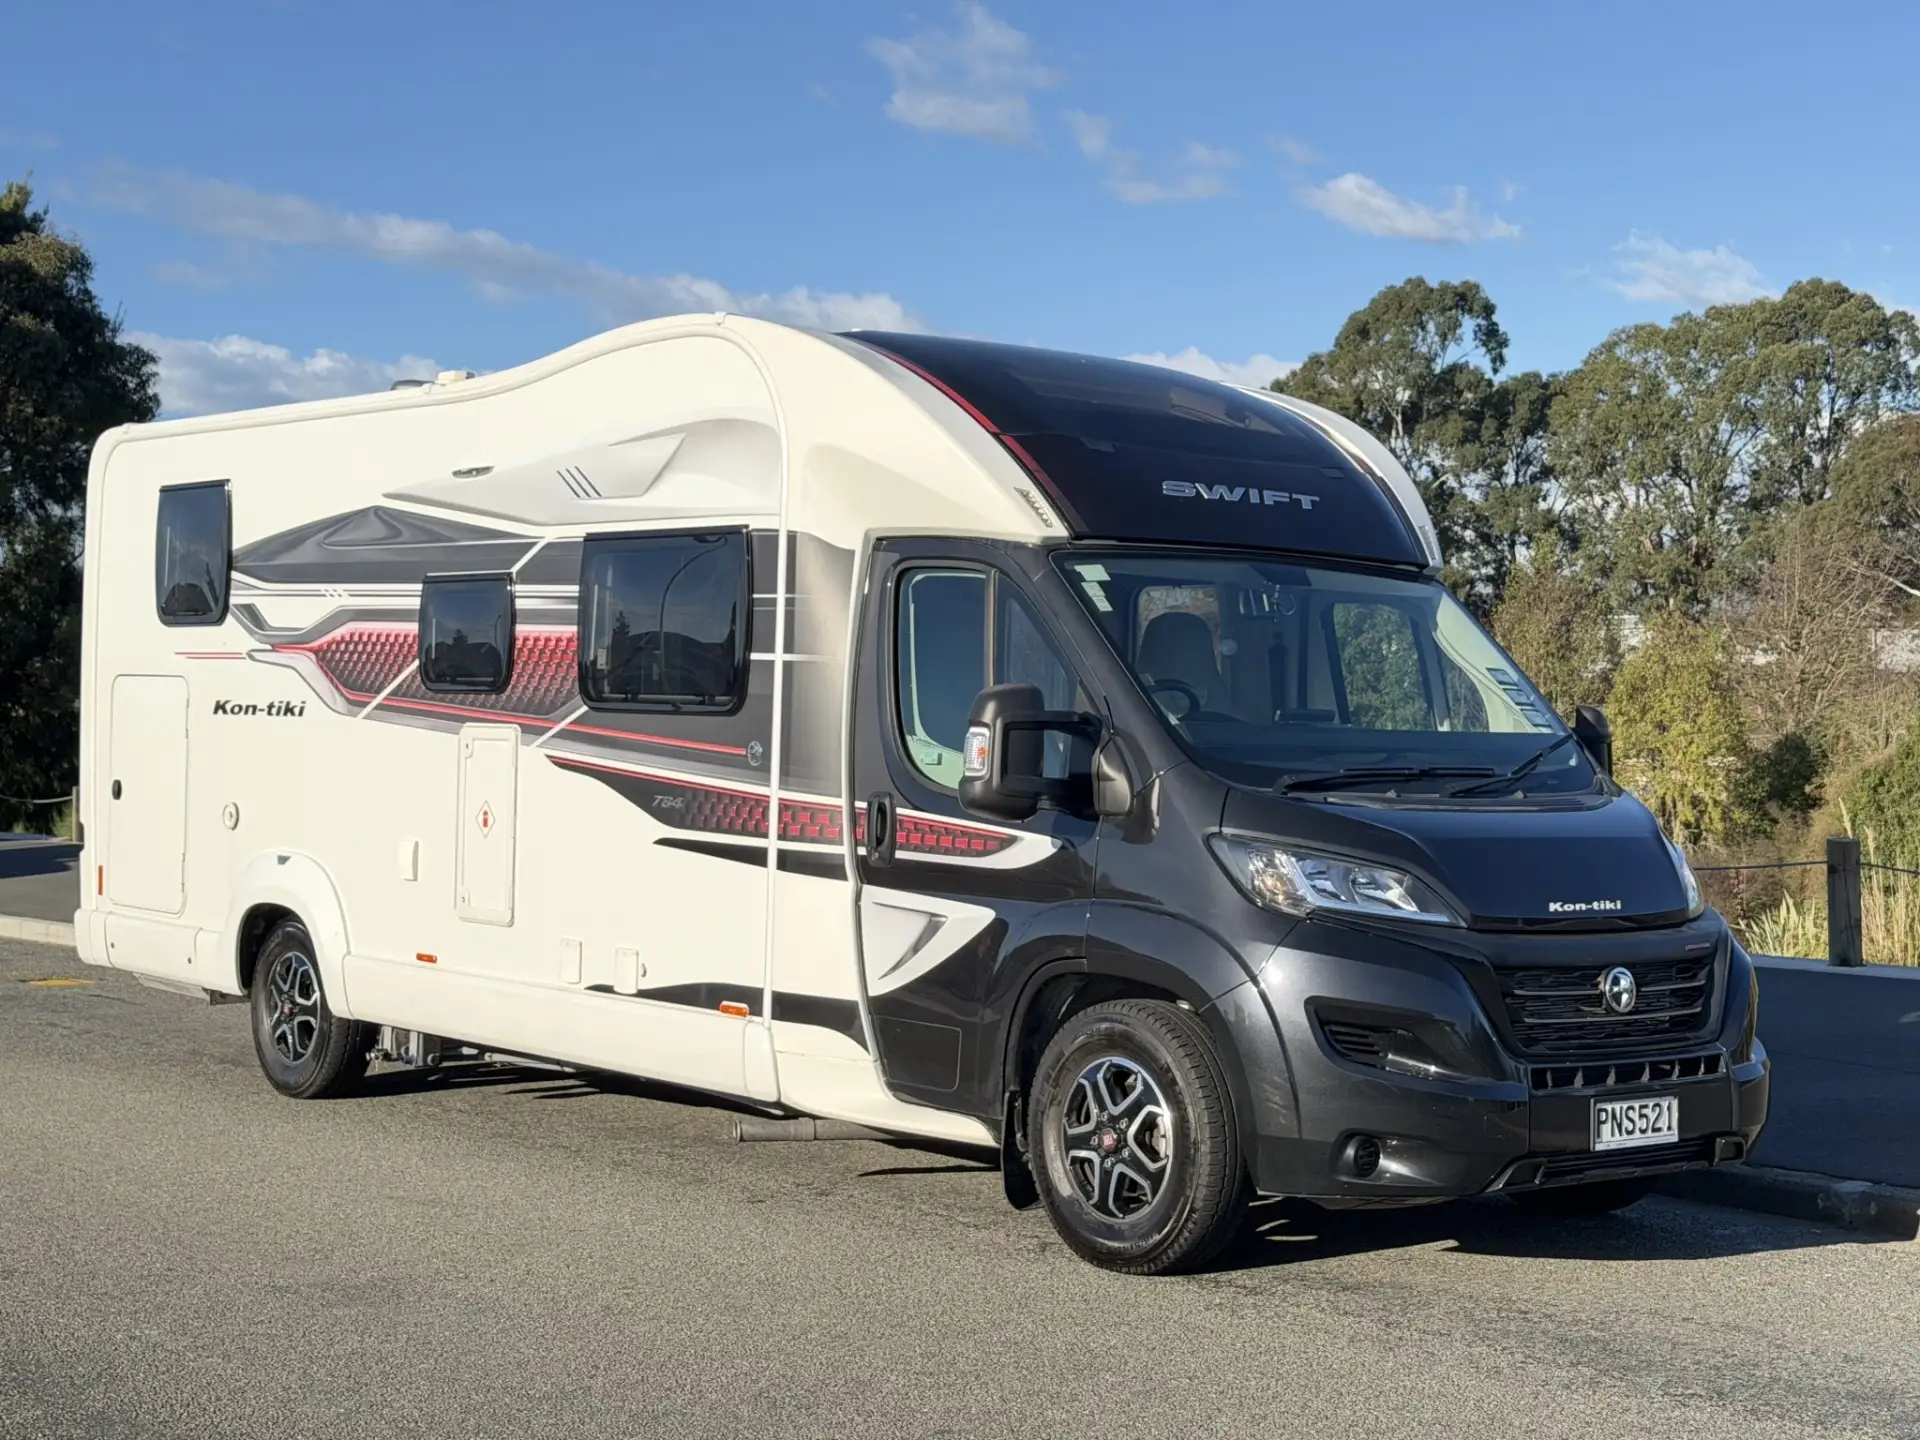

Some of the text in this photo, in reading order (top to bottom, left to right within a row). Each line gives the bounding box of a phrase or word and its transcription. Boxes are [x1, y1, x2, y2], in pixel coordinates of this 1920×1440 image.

[1161, 480, 1320, 510] SWIFT
[212, 699, 307, 717] Kon-tiki
[1548, 900, 1622, 913] Kon-tiki
[1596, 1100, 1672, 1140] PNS521
